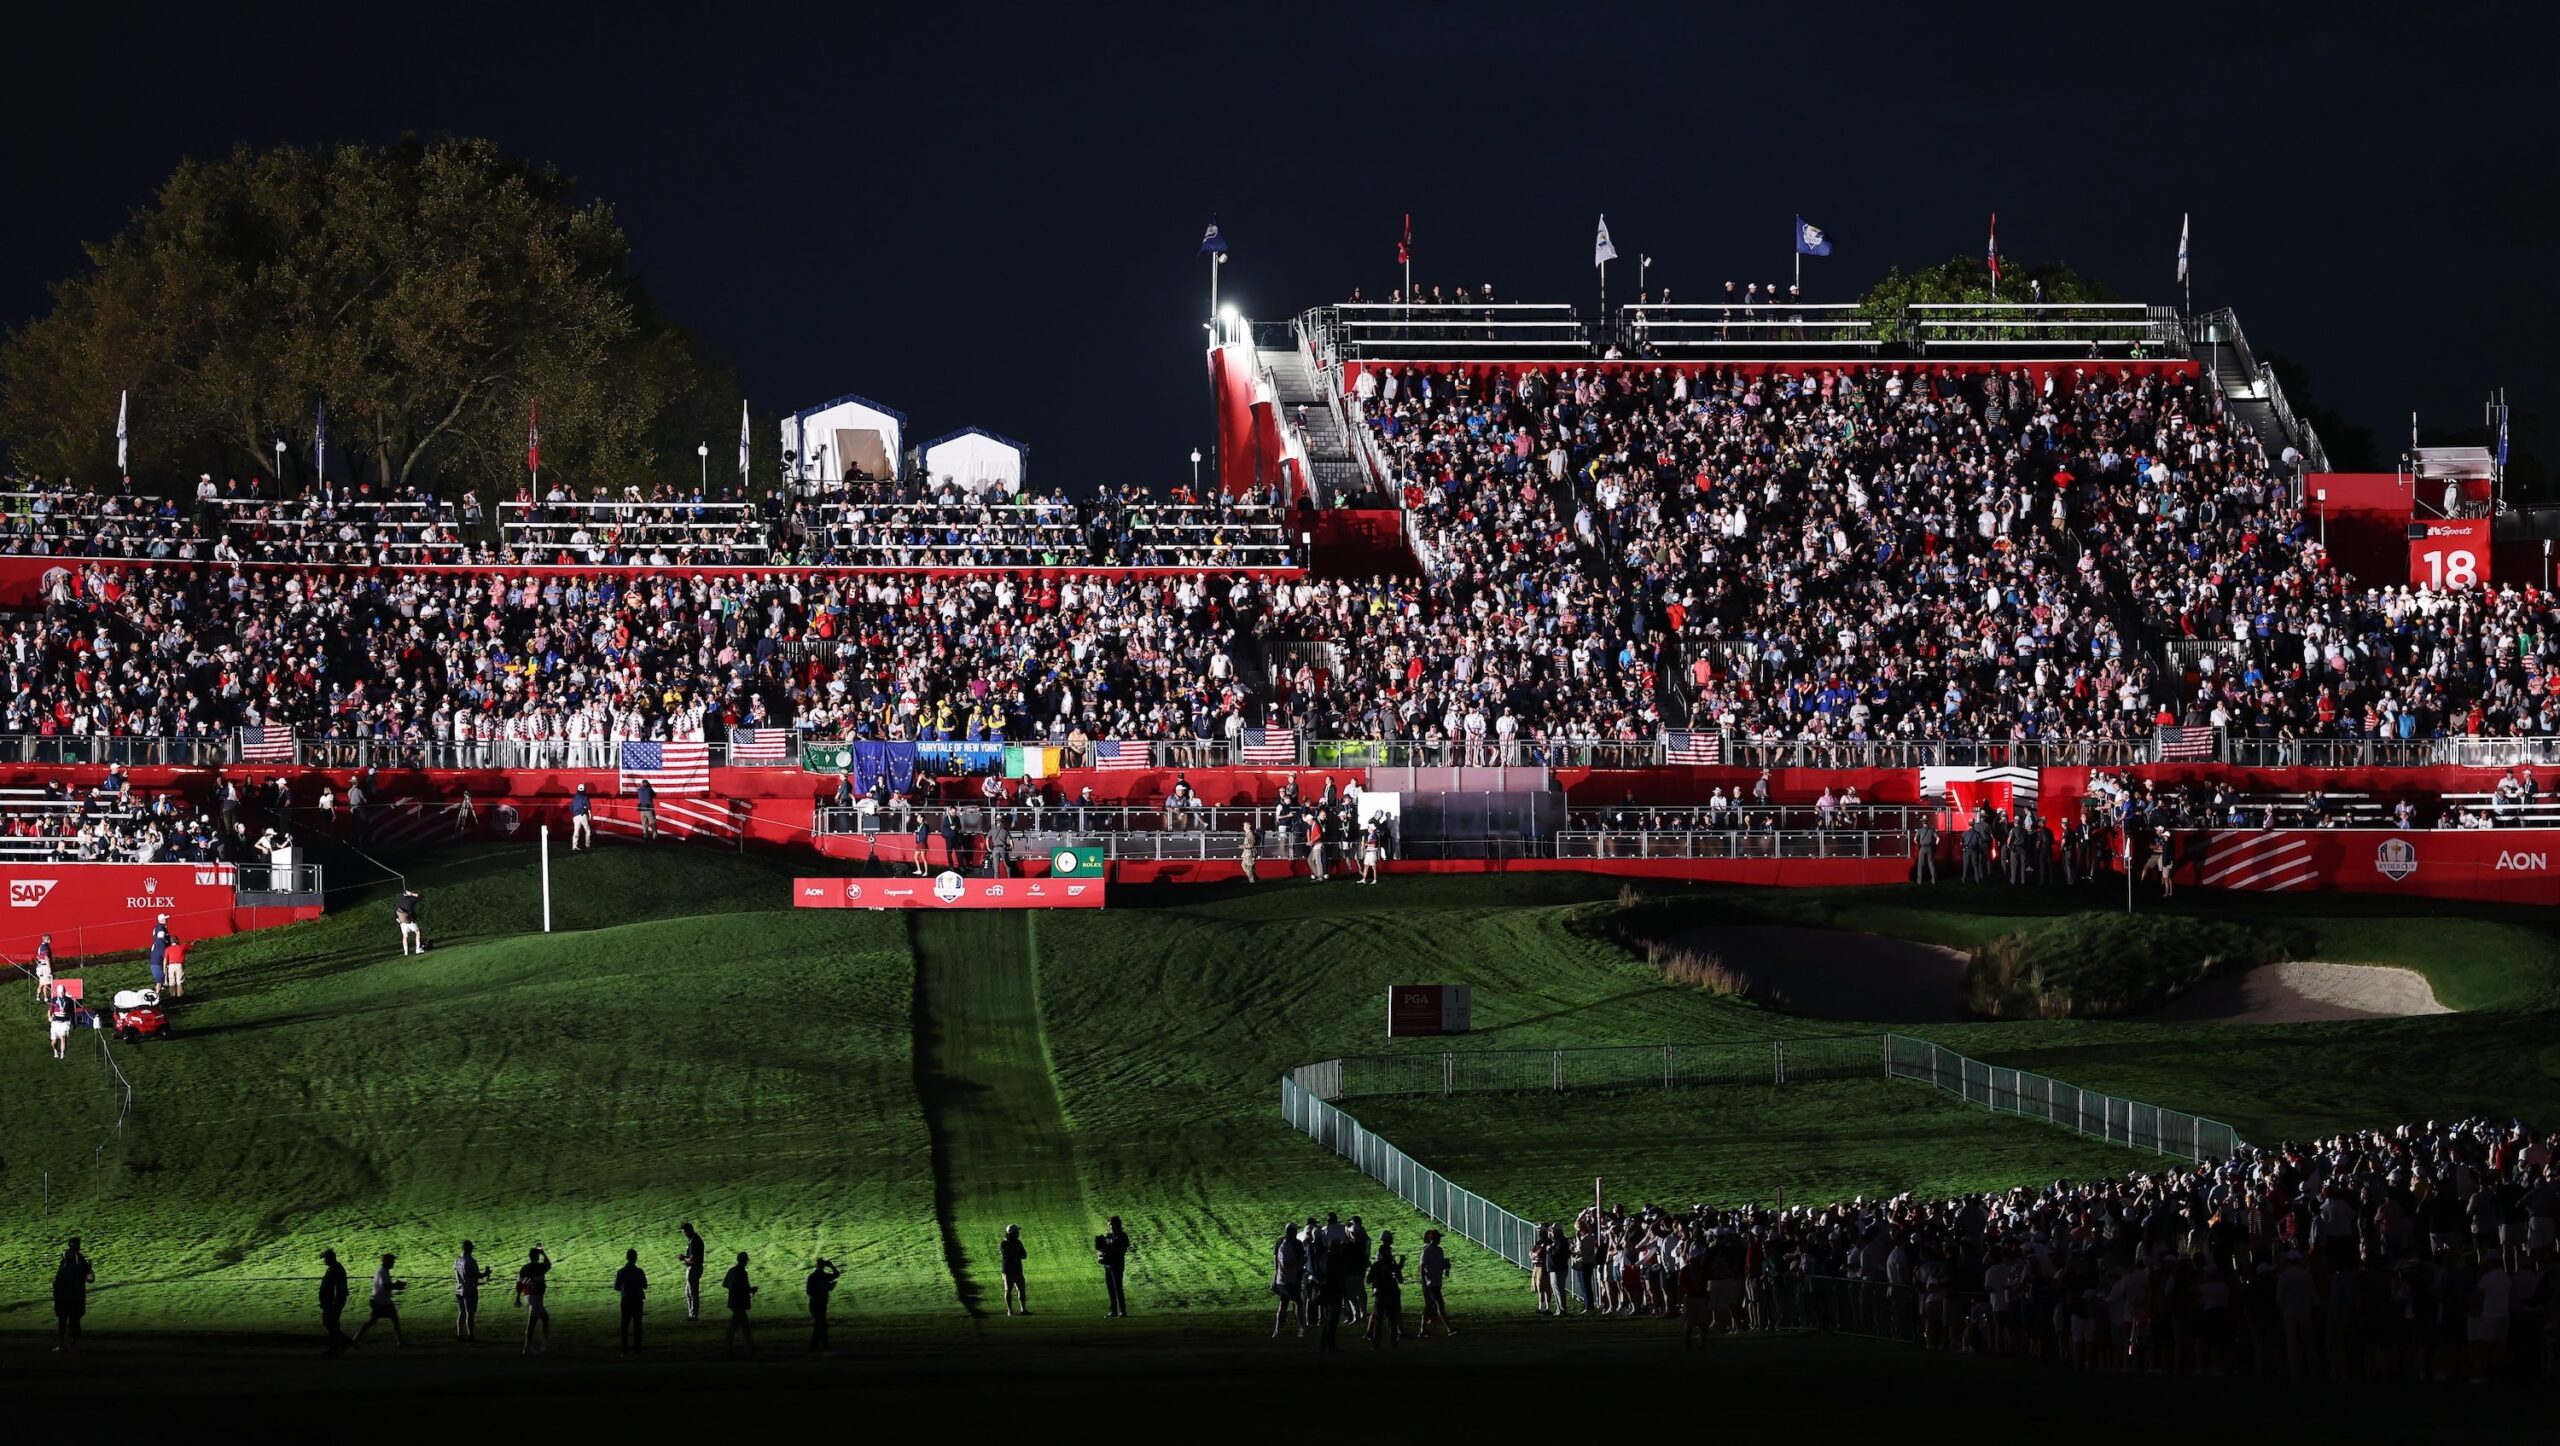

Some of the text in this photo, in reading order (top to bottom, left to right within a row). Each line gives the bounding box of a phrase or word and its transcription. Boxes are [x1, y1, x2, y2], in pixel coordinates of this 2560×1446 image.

[2441, 526, 2473, 537] Sports
[2423, 550, 2477, 591] 18
[918, 743, 1002, 752] FAIRYTALE OF NEW YORK?
[2495, 850, 2546, 870] AON
[12, 885, 46, 901] SAP
[805, 888, 824, 896] AON
[986, 885, 1004, 896] citi
[127, 897, 175, 908] ROLEX
[1404, 994, 1429, 1004] PGA
